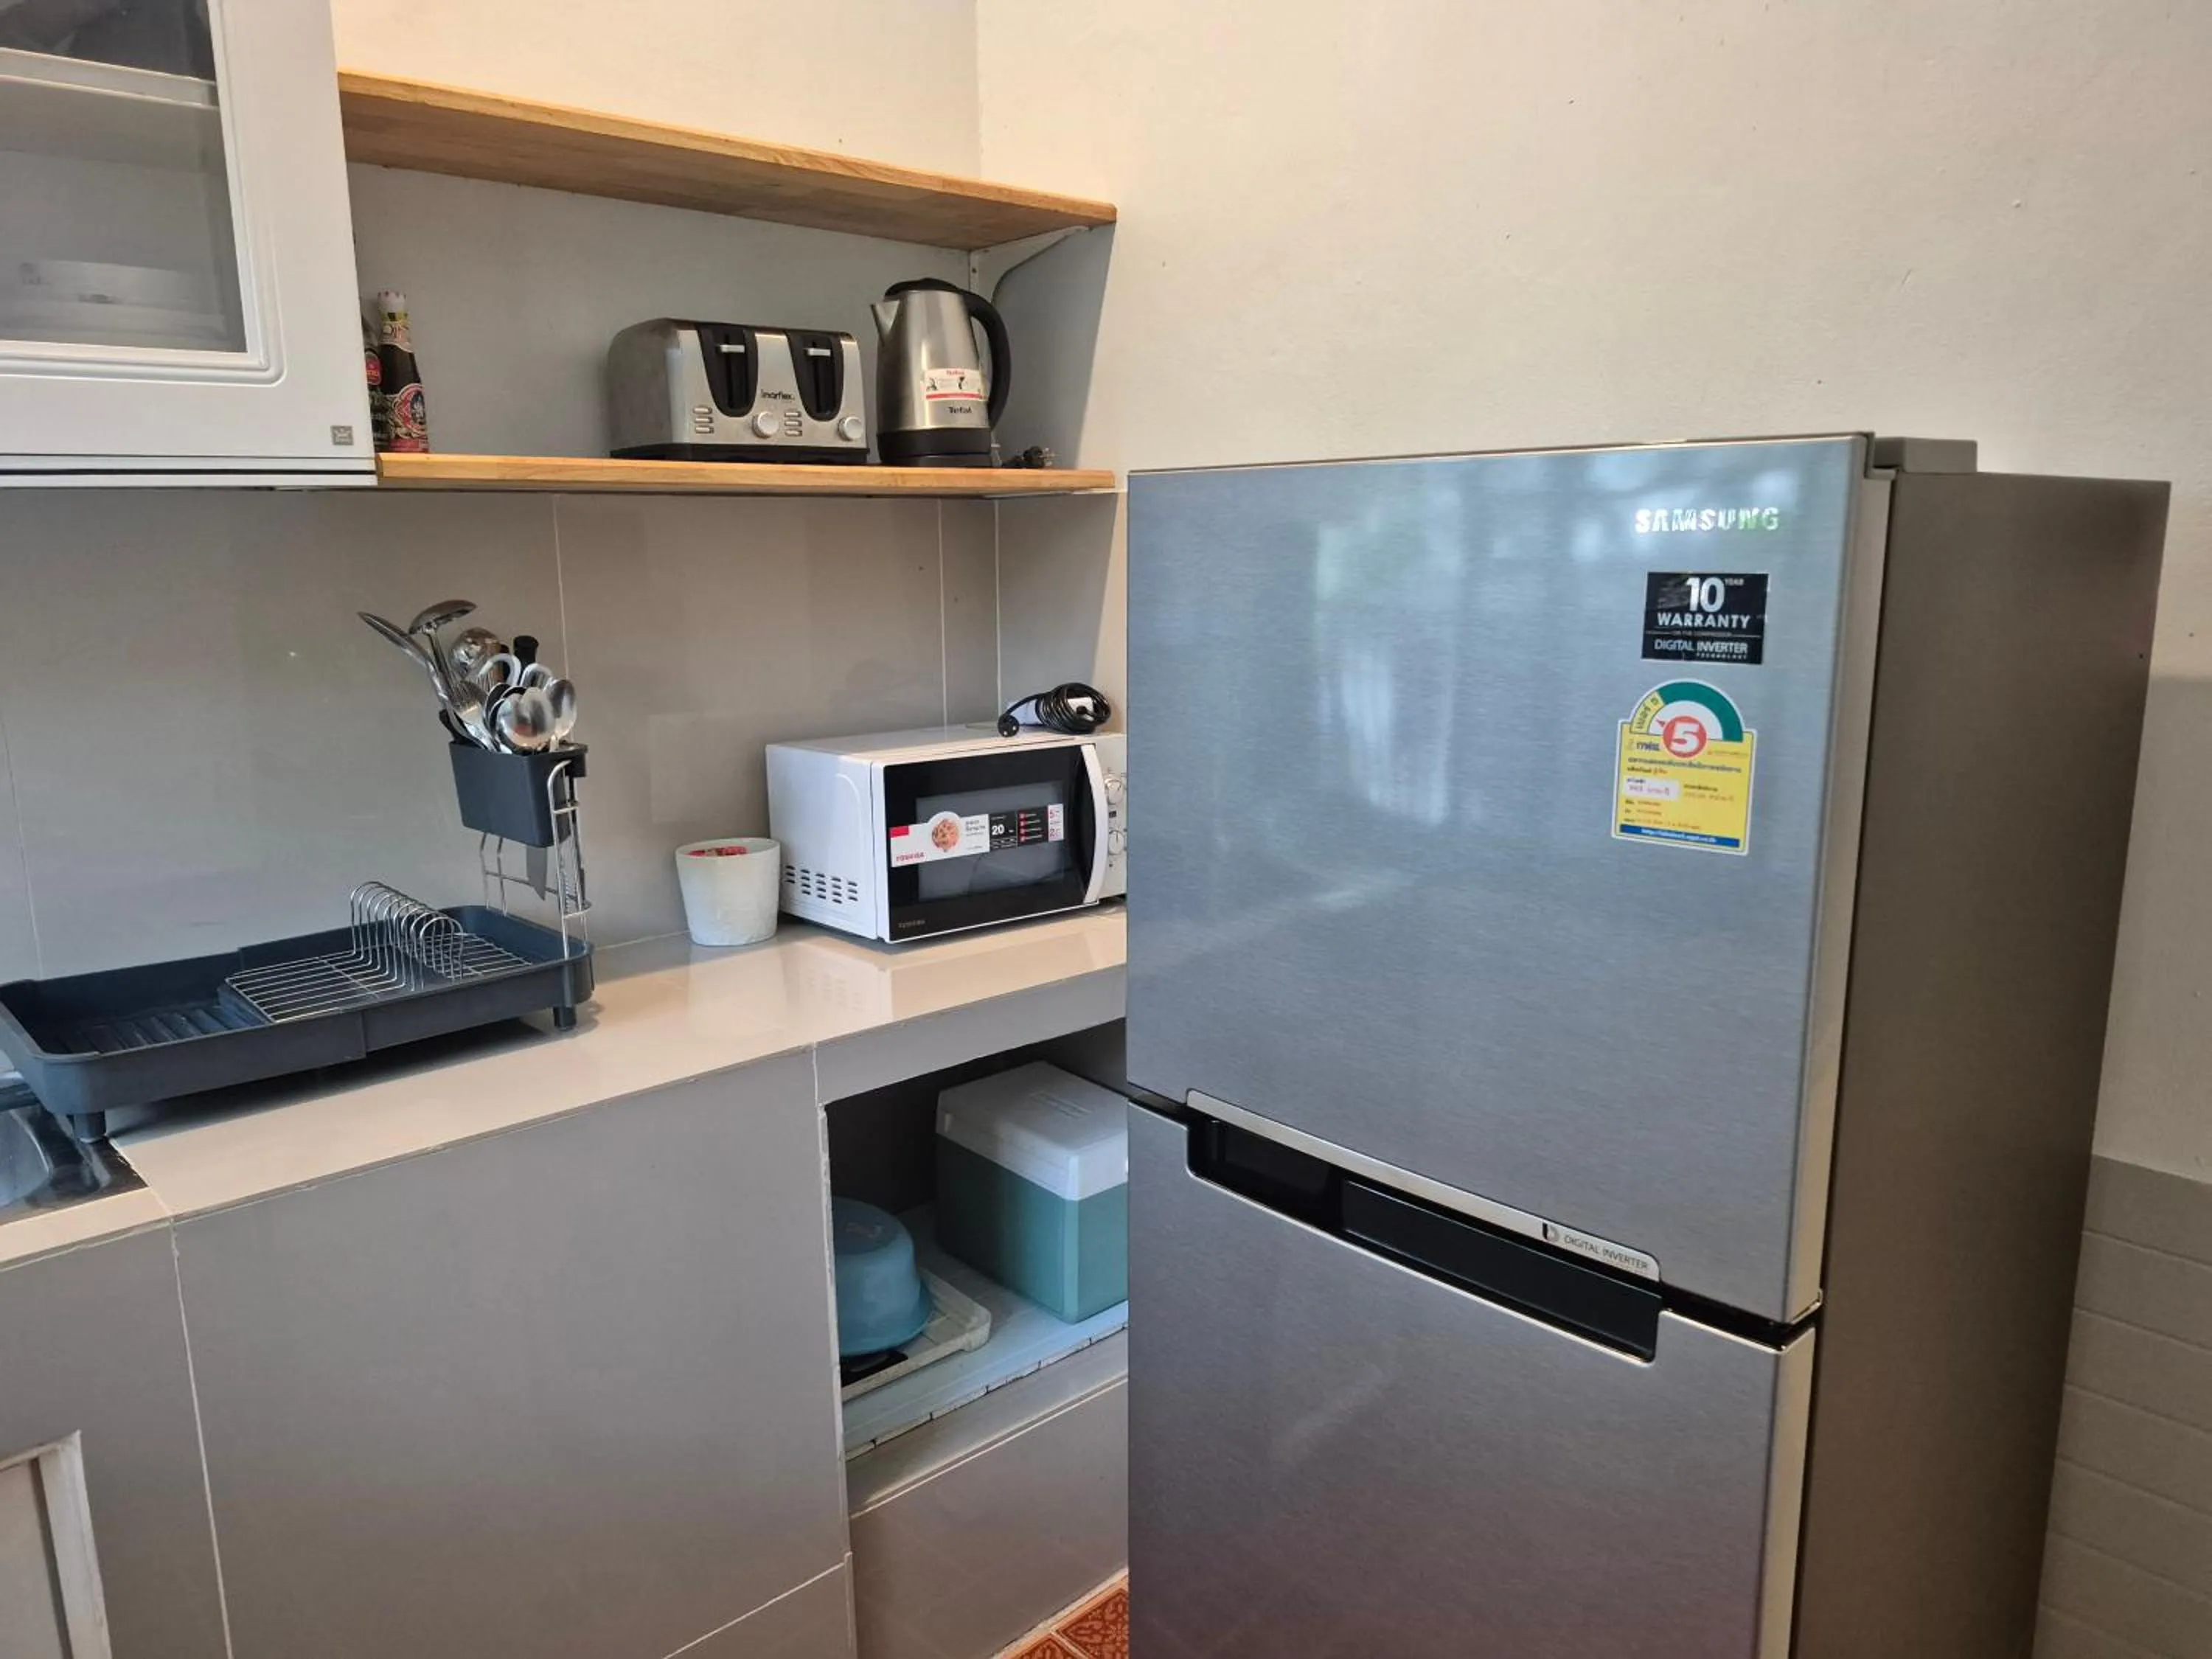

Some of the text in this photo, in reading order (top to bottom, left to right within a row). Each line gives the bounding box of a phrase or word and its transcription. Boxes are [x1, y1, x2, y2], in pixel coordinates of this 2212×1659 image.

[1635, 507, 1779, 533] SAMSUNG
[1686, 577, 1725, 613] 10
[1657, 612, 1750, 629] WARRANTY
[1654, 639, 1748, 654] DIGITAL INVERTER
[1670, 722, 1700, 753] 5
[992, 824, 1005, 835] 20
[1563, 1234, 1649, 1269] DIGITAL INVERTER
